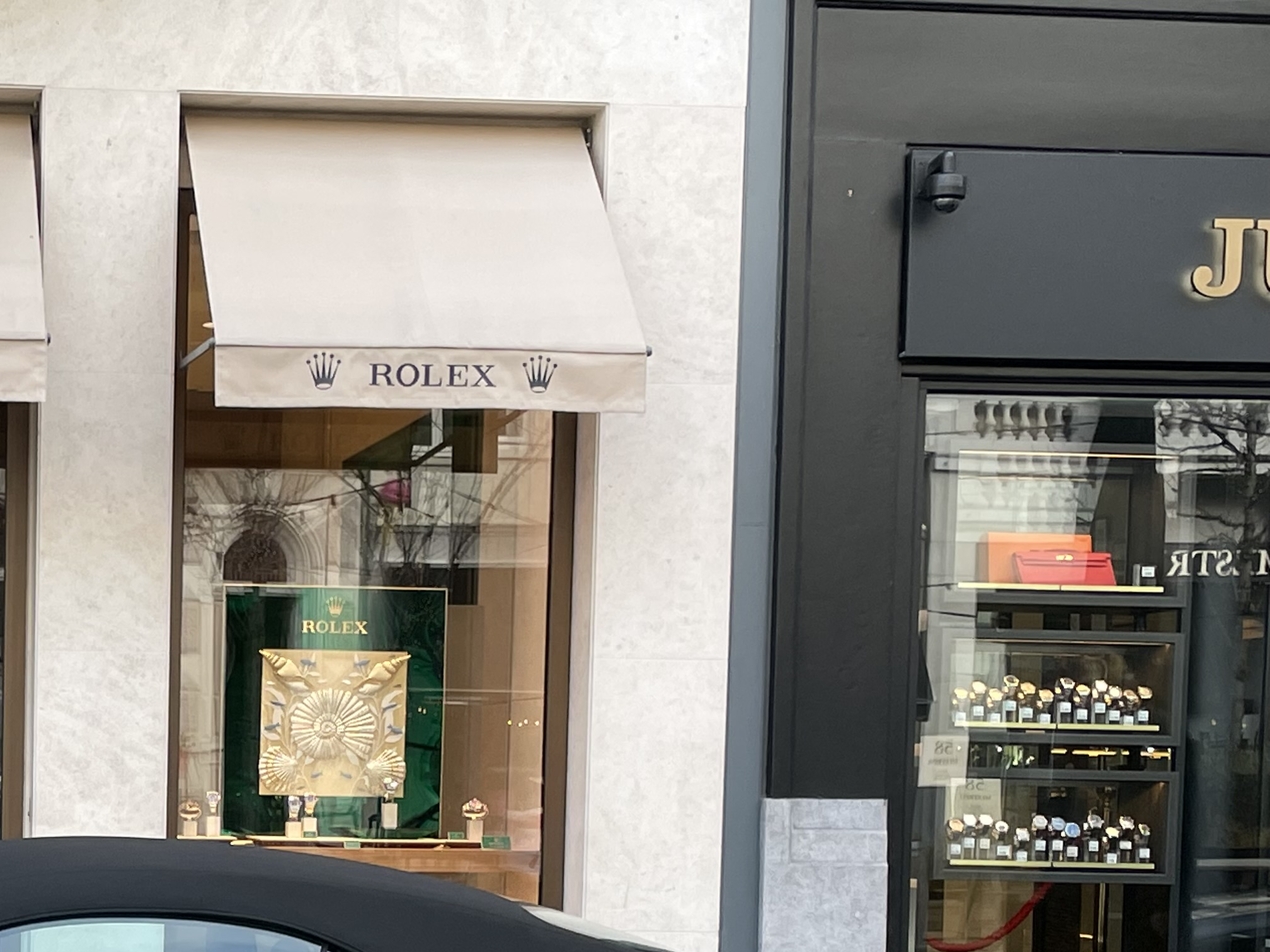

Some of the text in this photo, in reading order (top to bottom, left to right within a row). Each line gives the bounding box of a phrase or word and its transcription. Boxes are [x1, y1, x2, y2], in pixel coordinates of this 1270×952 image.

[1191, 217, 1270, 298] J
[368, 362, 497, 388] ROLEX
[301, 619, 369, 635] ROLEX
